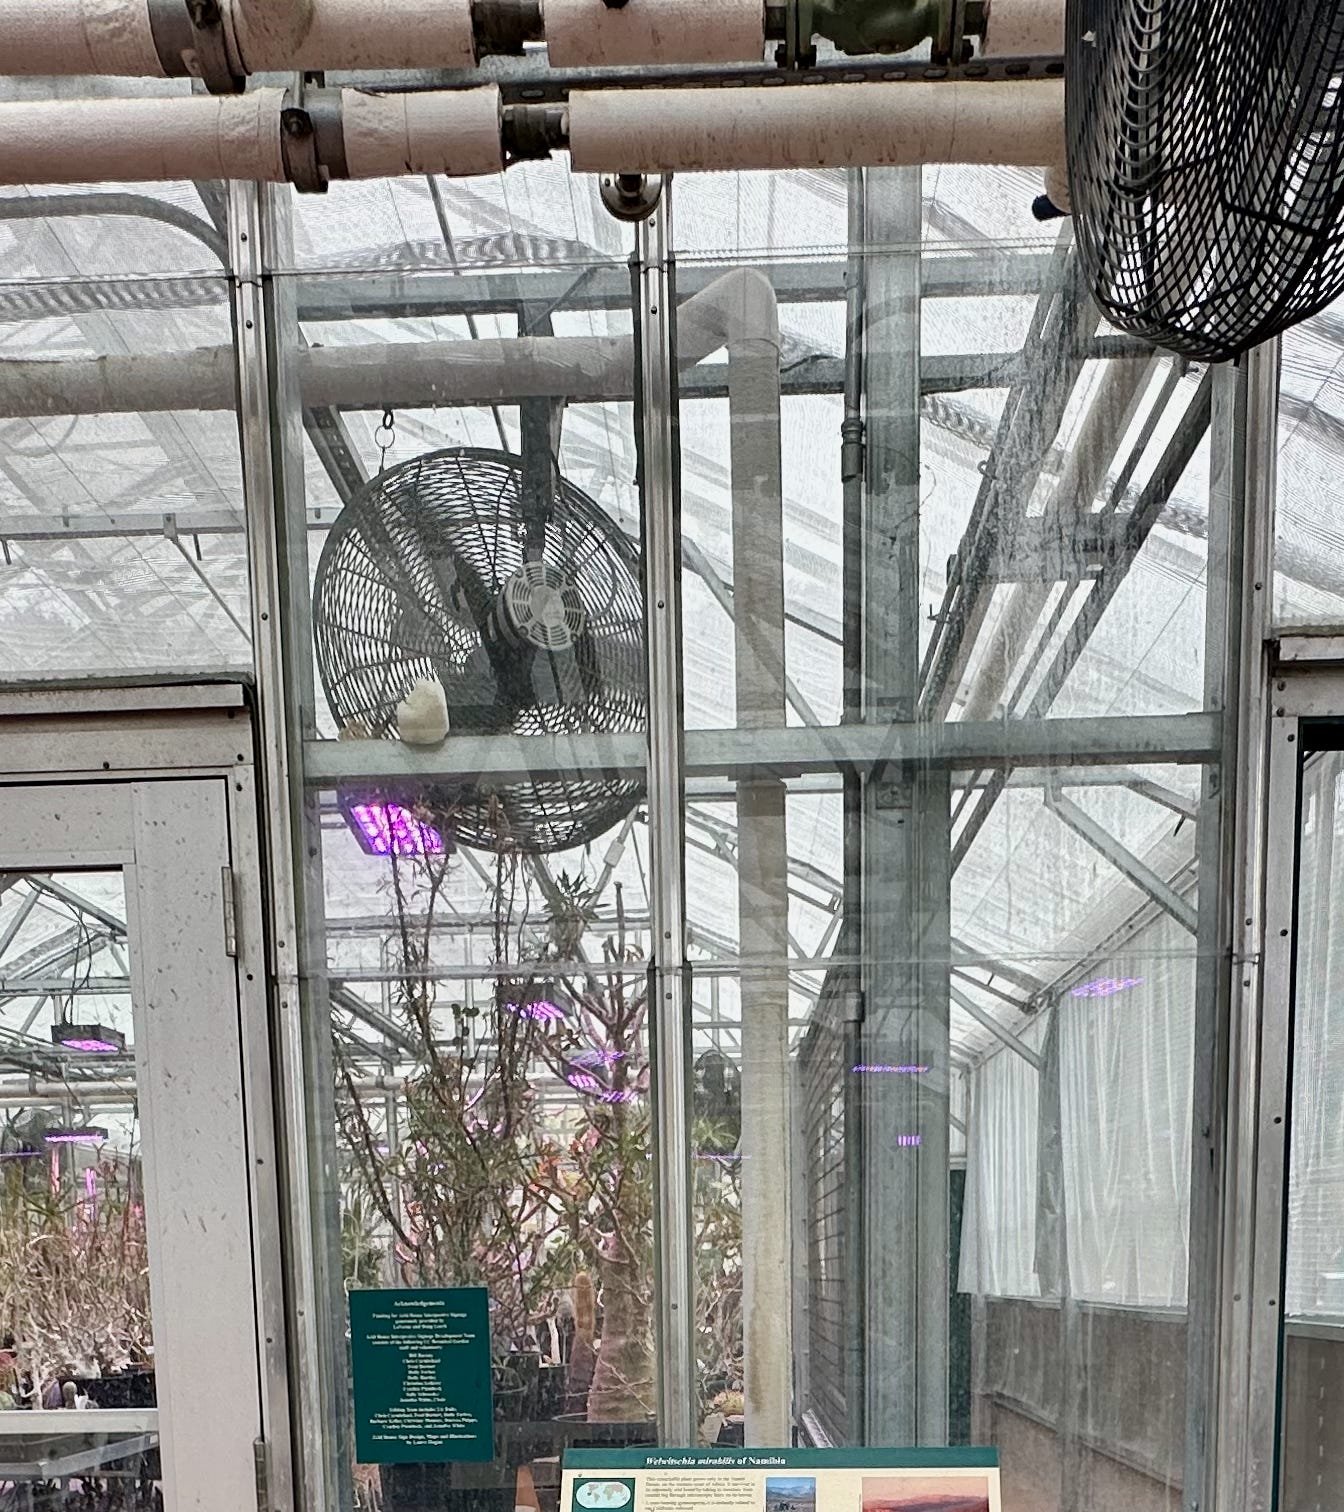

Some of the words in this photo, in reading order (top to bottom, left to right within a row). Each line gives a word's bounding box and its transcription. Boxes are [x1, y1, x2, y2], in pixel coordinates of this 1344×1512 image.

[646, 1456, 696, 1466] Welwitschia
[737, 1456, 747, 1465] of
[749, 1456, 787, 1465] Namibia
